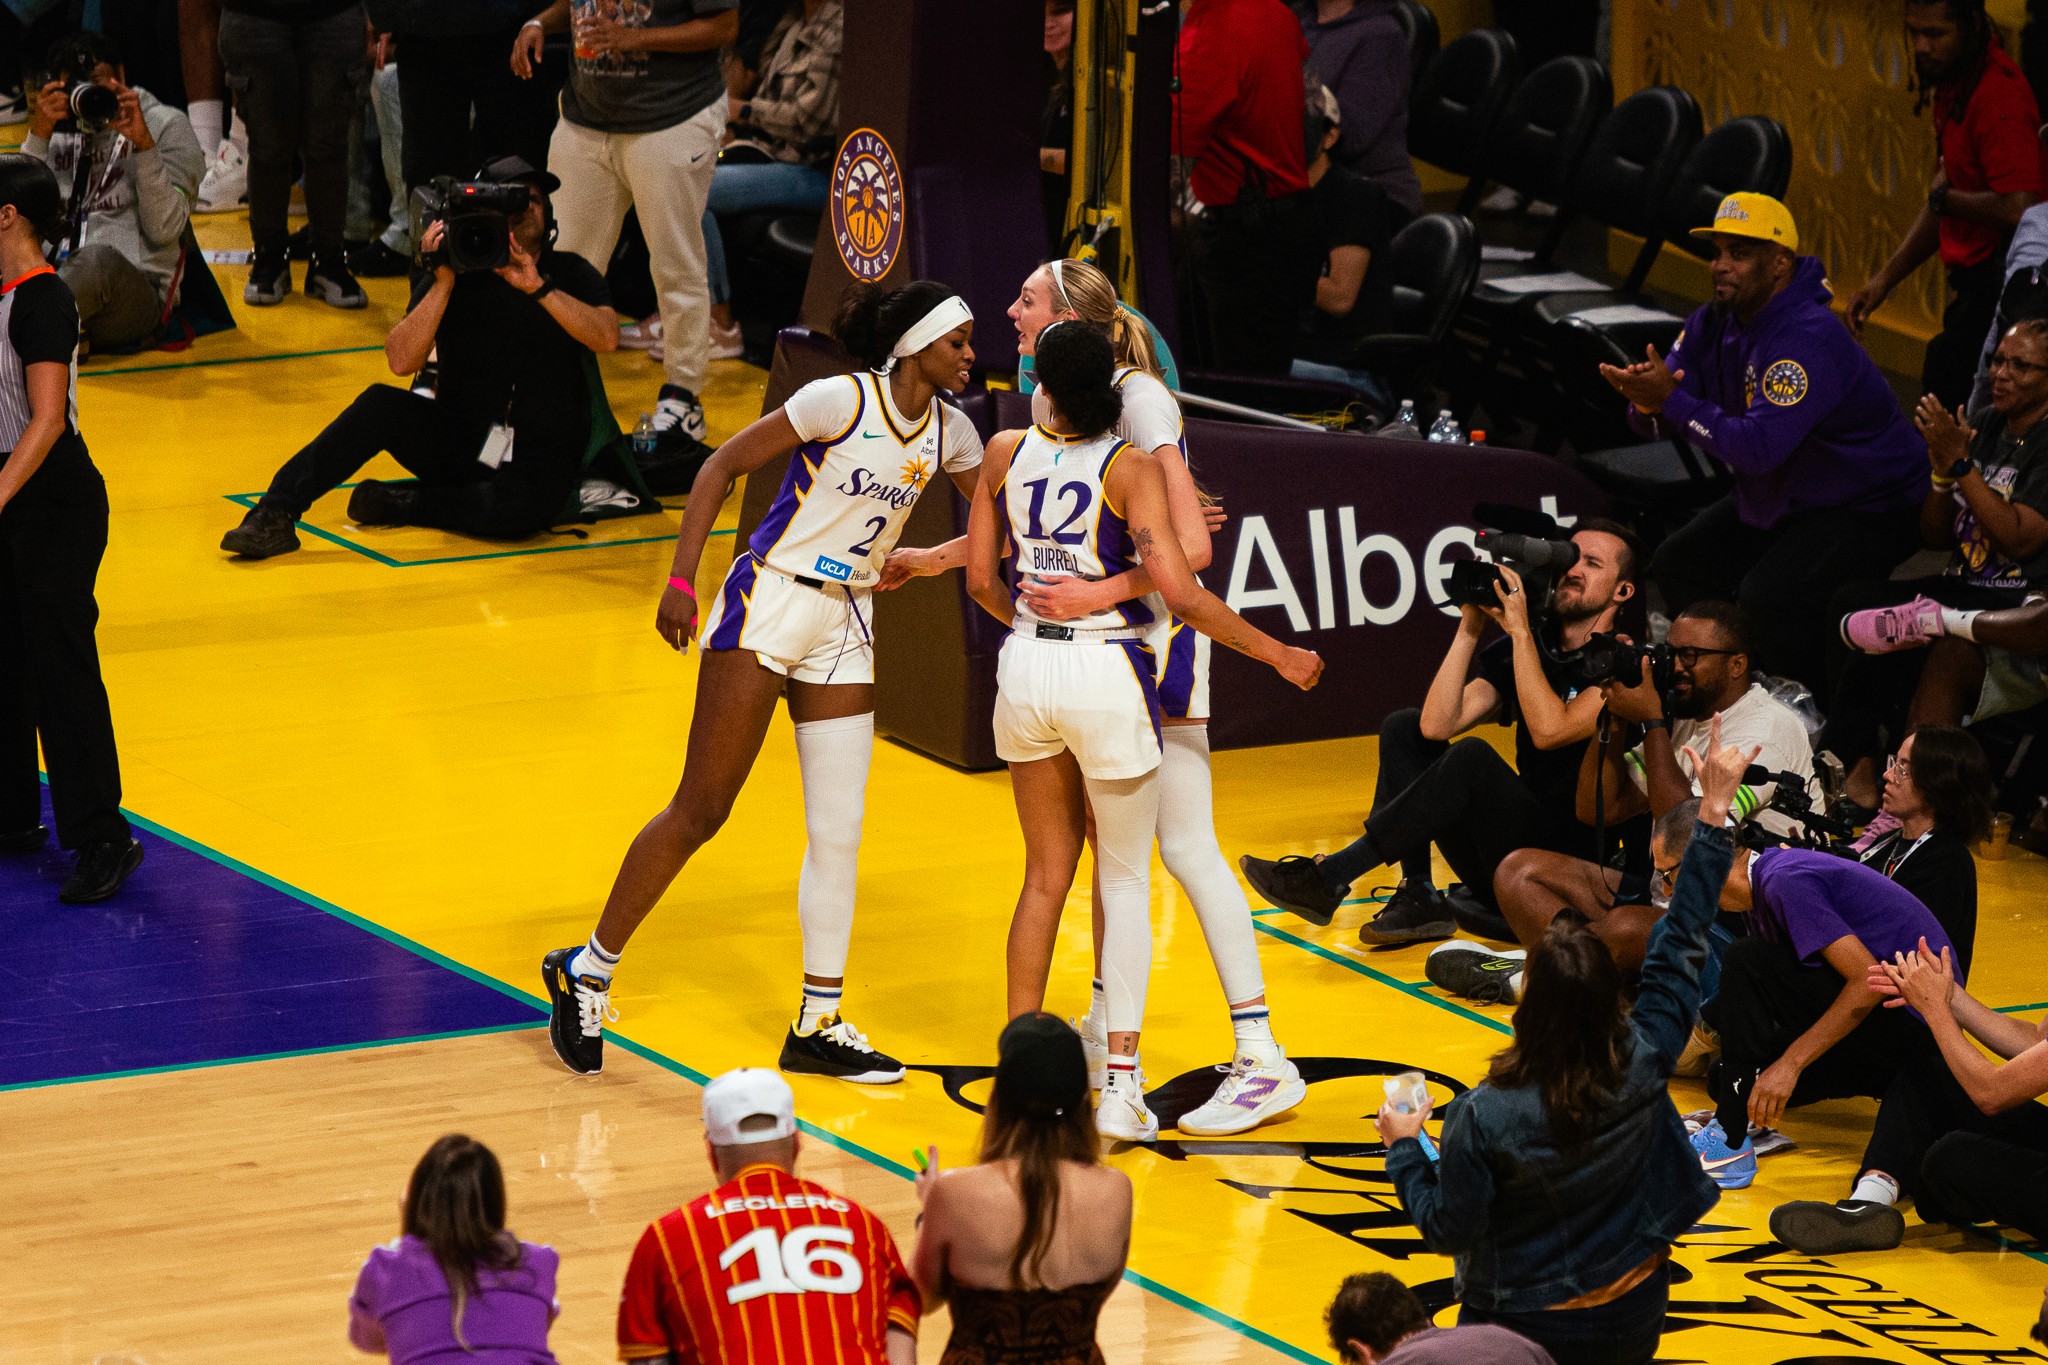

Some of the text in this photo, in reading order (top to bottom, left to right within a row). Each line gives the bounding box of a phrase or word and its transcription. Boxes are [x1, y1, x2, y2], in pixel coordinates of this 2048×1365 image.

[834, 136, 900, 222] LOS ANGELES
[839, 232, 890, 275] SPARKS
[1022, 478, 1093, 545] 12
[848, 516, 887, 557] 2
[820, 560, 847, 578] UCLA
[705, 1193, 851, 1219] LECLERC
[719, 1225, 864, 1305] 16
